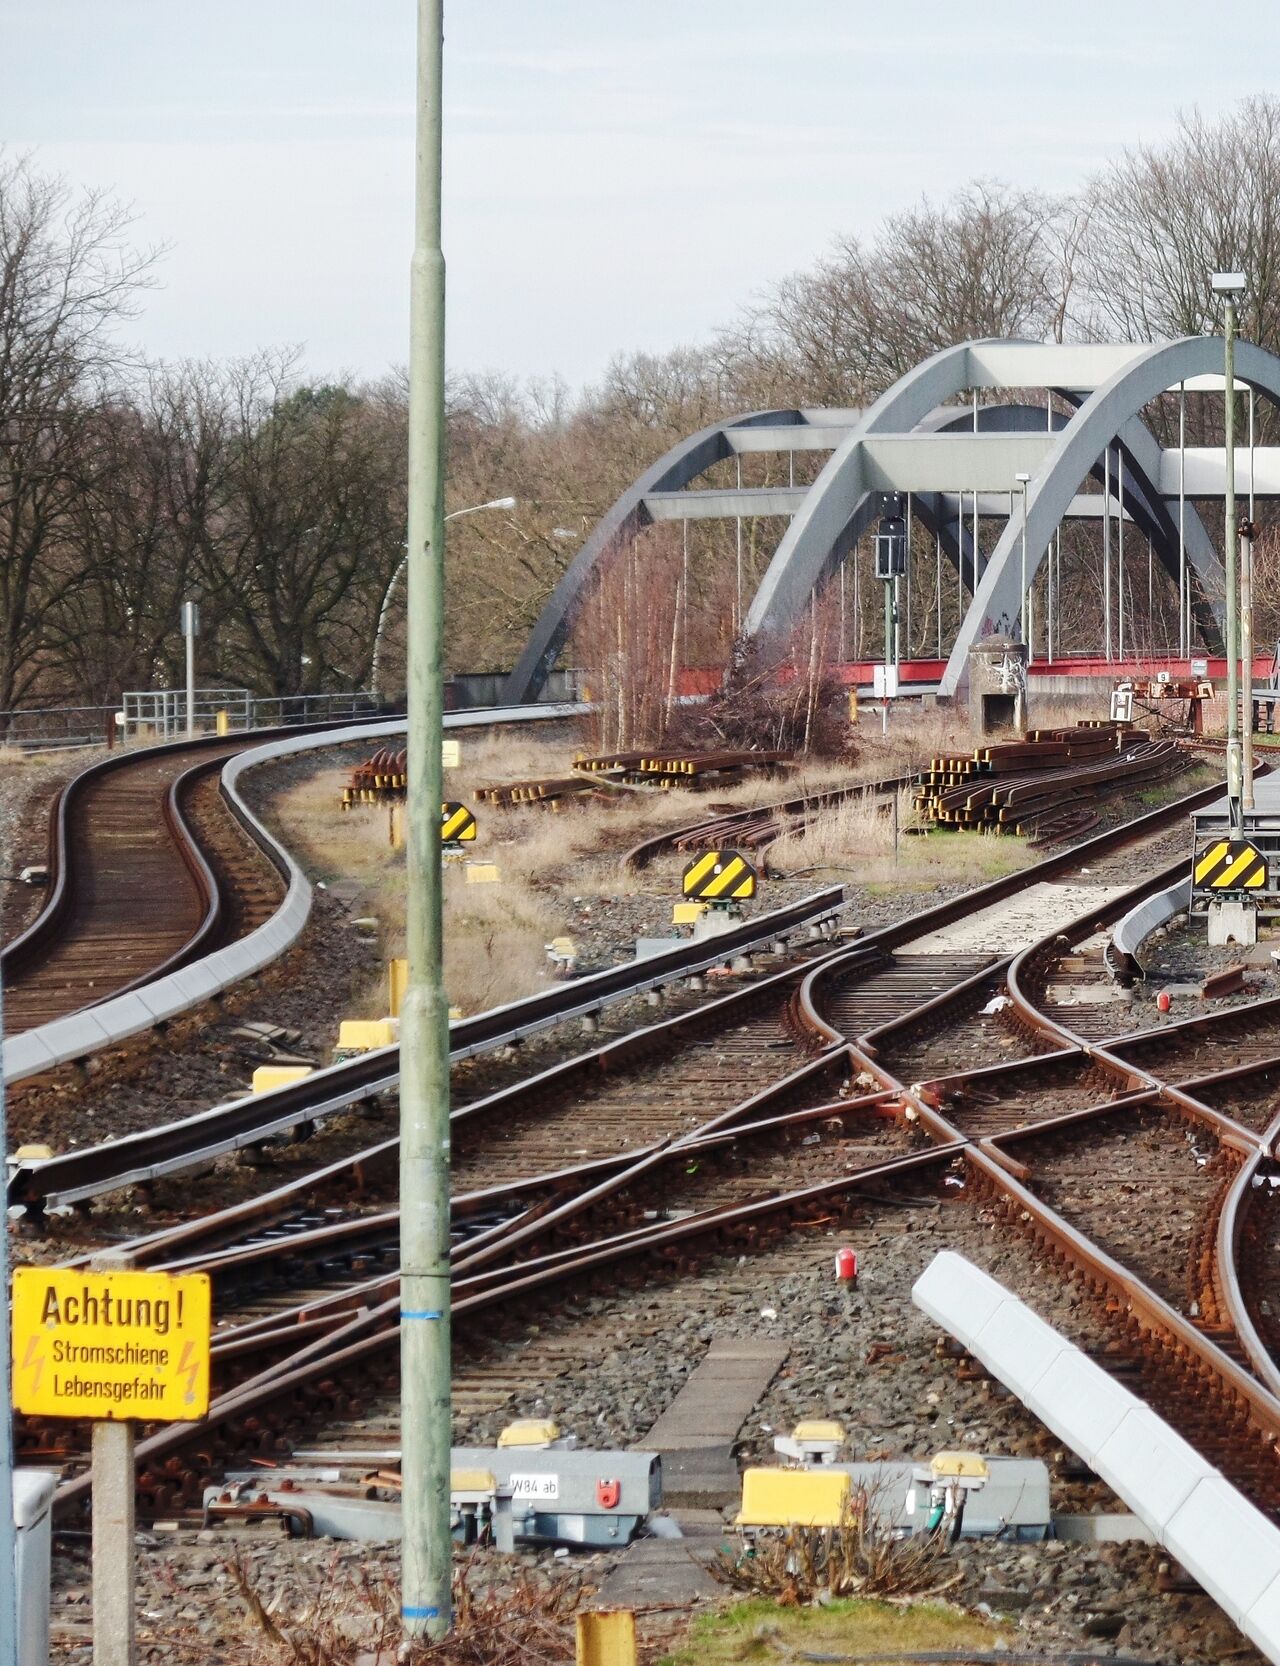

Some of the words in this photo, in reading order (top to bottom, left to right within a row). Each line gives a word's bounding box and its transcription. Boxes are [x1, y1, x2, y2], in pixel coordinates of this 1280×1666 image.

[40, 1286, 184, 1335] Achtung!
[53, 1340, 169, 1365] Stromschiene
[54, 1375, 167, 1402] Lebensgefahr
[511, 1479, 538, 1493] W84
[543, 1479, 556, 1493] ab
